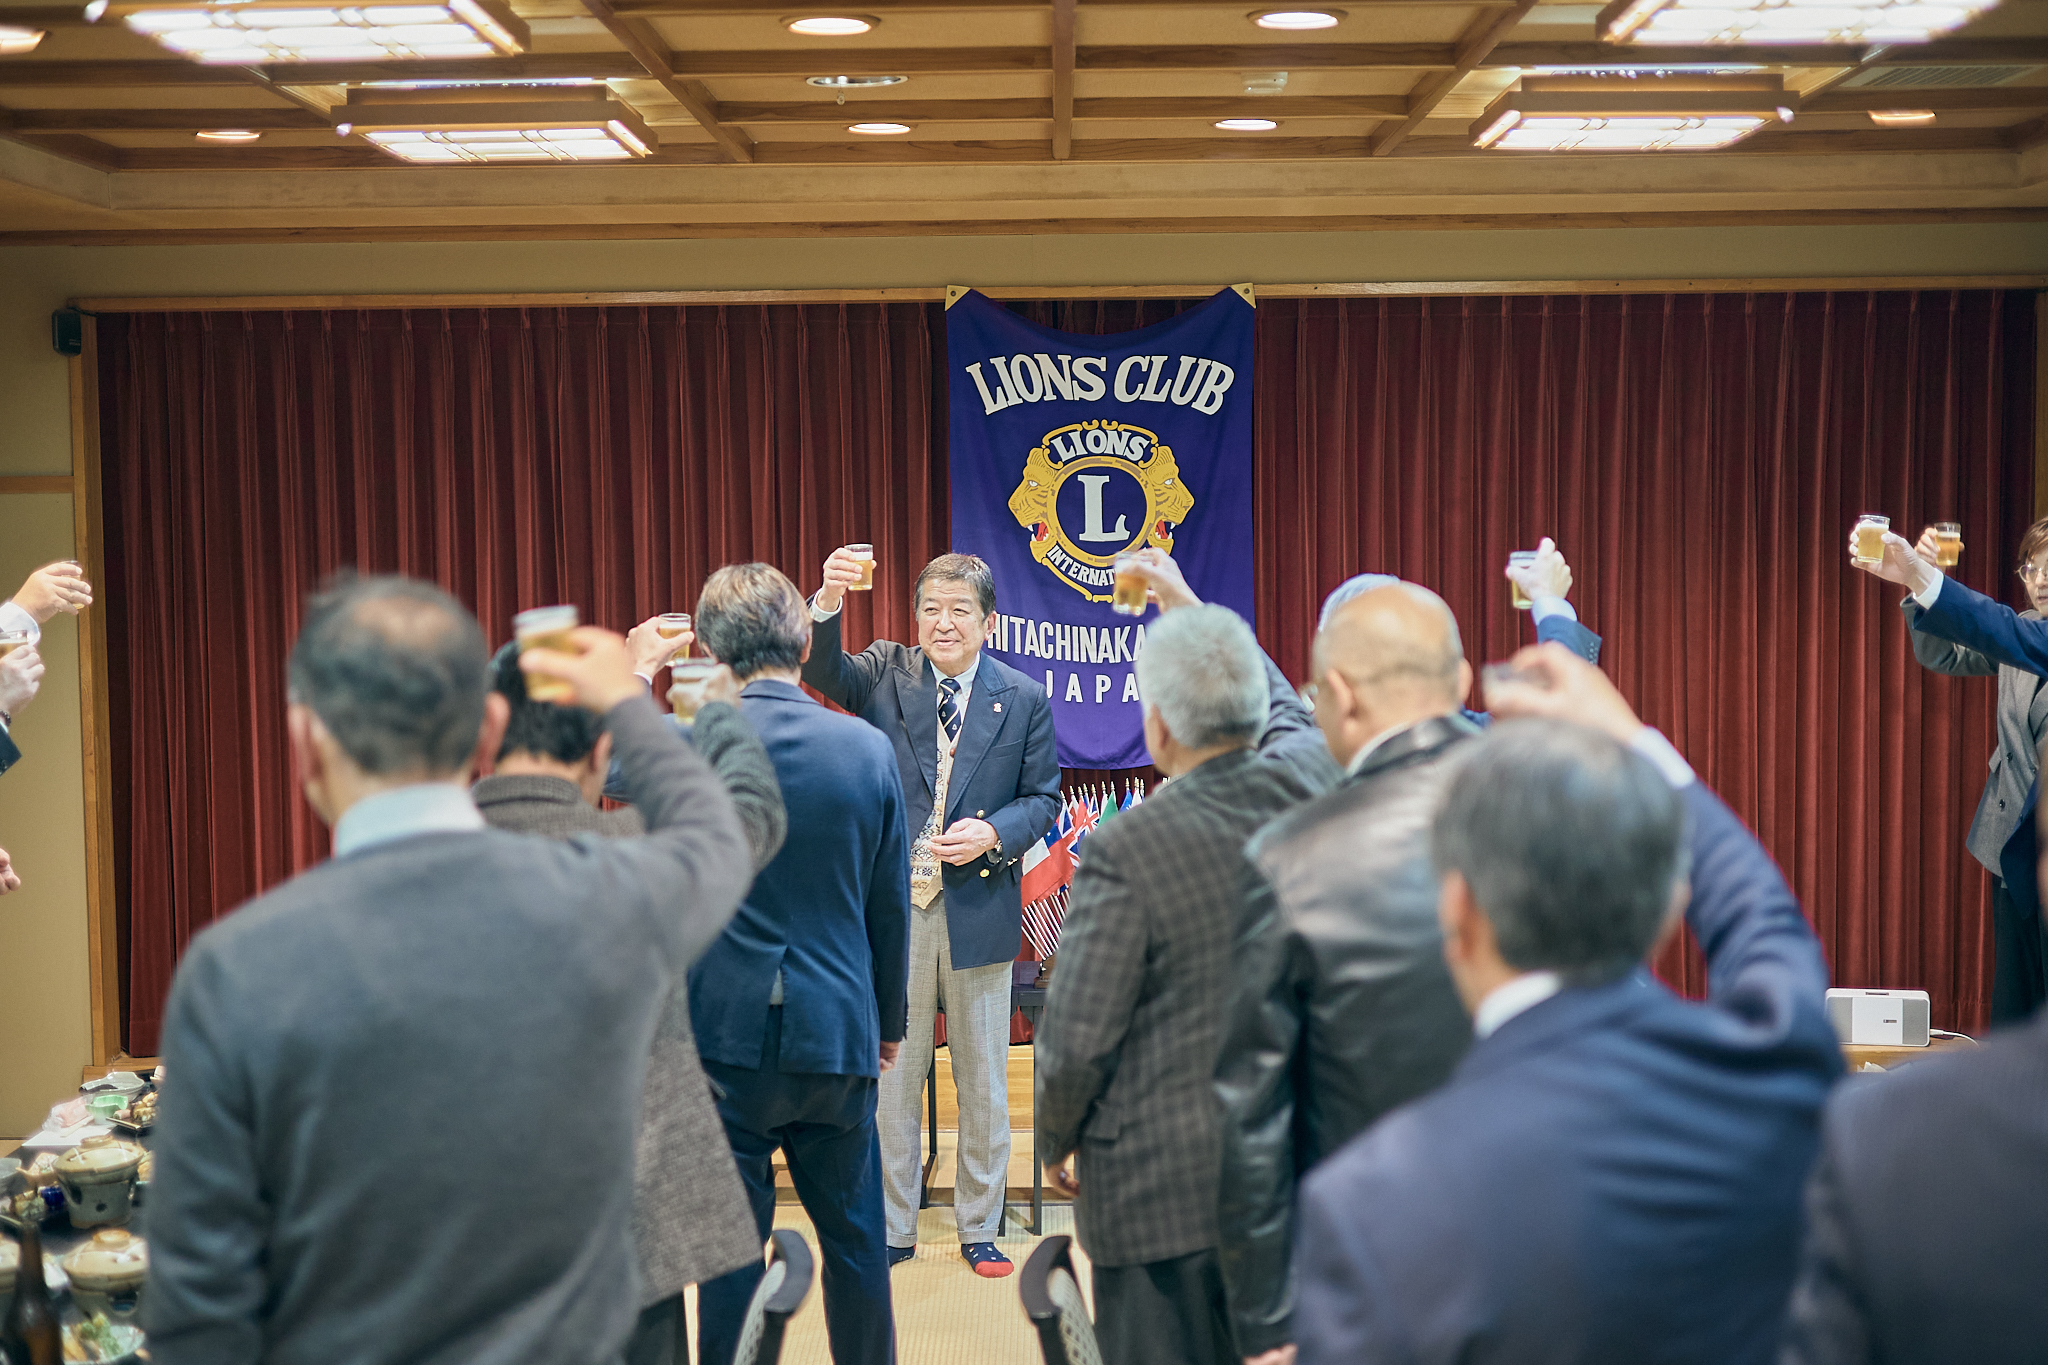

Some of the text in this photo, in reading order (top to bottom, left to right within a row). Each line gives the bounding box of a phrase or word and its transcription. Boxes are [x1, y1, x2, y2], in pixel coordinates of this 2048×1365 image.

[965, 353, 1235, 416] LIONS CLUB
[1050, 429, 1150, 462] LIONS
[1077, 474, 1131, 542] L
[1046, 544, 1116, 587] INTERNAT
[1045, 669, 1140, 704] JAPA
